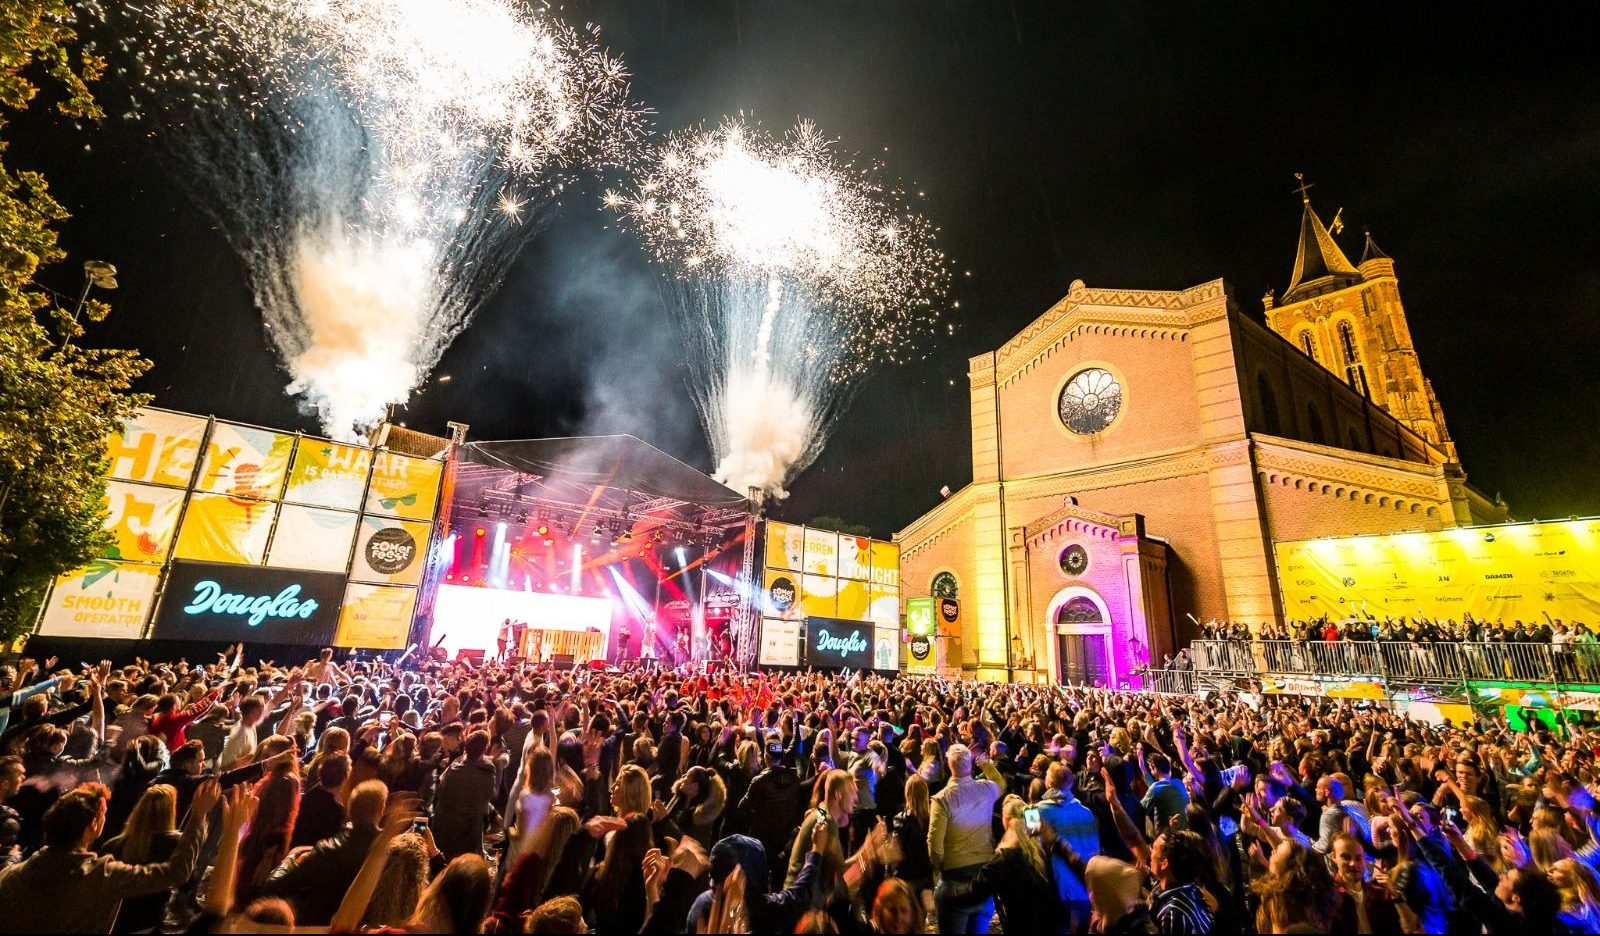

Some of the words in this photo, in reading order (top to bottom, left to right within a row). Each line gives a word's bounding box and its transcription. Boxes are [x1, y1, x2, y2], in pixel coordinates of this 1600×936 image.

[105, 432, 241, 490] HEY
[328, 444, 410, 479] WAAR
[62, 595, 142, 612] SMOOTH
[74, 612, 142, 624] OPERATOR
[184, 580, 319, 626] Douglas
